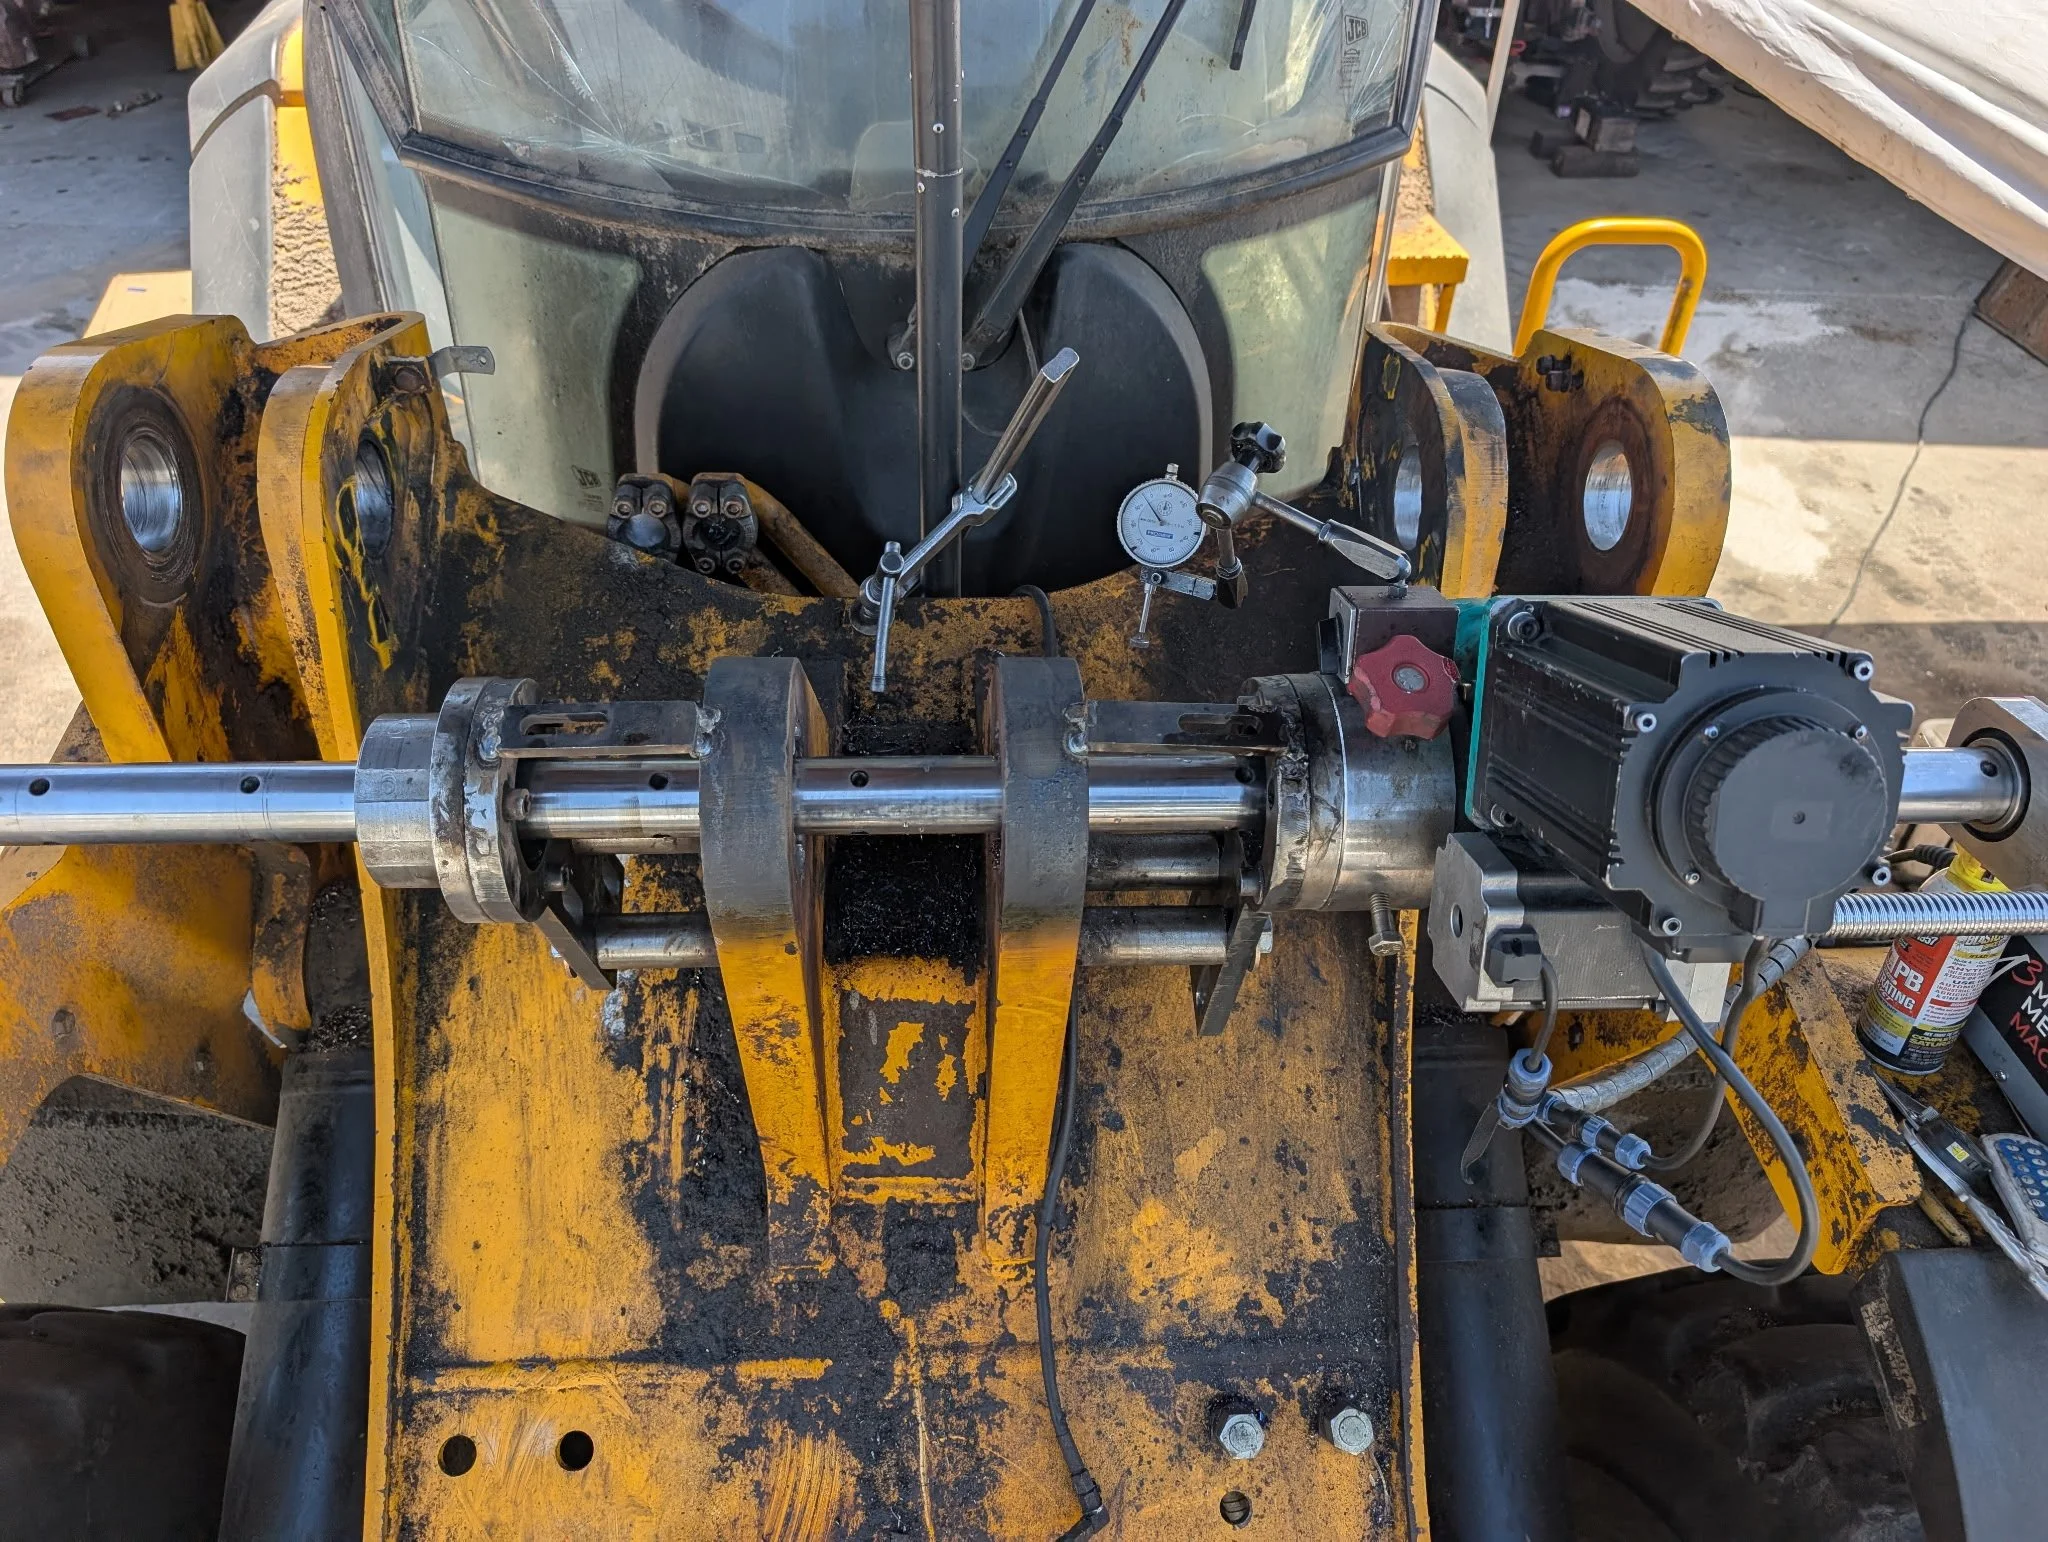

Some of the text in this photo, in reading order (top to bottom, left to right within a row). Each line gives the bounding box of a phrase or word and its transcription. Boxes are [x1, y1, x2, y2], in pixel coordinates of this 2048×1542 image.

[1346, 17, 1367, 42] JCB
[1893, 960, 1924, 993] PB
[2011, 959, 2043, 986] 3
